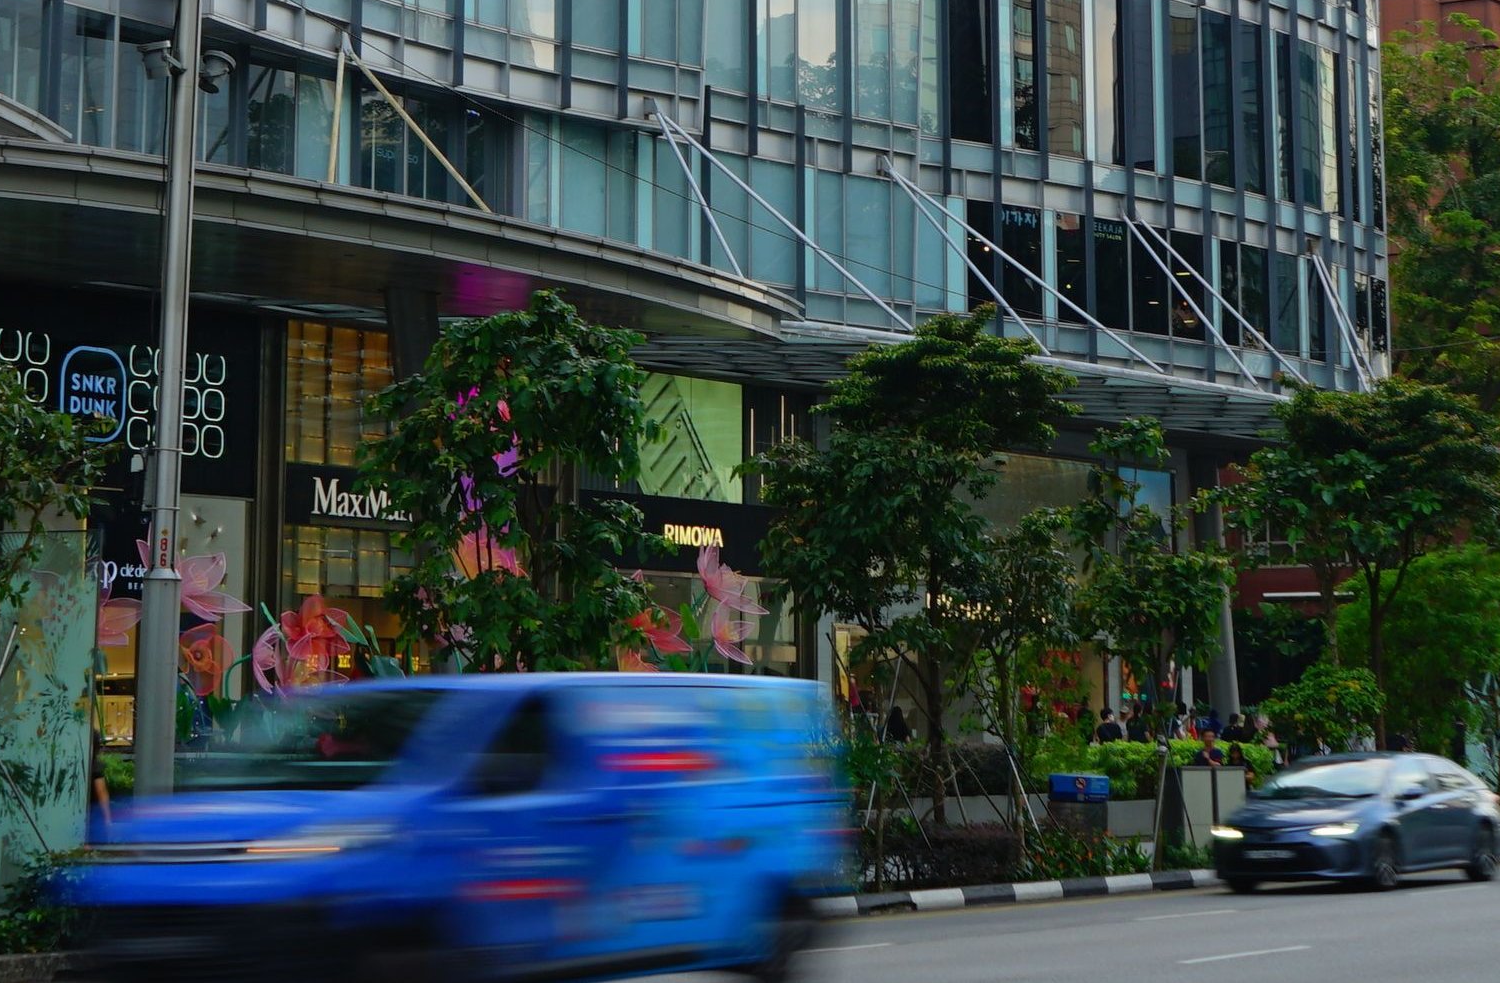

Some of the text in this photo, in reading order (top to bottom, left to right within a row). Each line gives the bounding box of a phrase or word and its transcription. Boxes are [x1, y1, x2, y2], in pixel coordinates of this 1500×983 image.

[1093, 221, 1124, 235] EEKAJA
[71, 372, 117, 396] SNKR
[69, 396, 117, 418] DUNK
[311, 477, 413, 522] MaxM
[664, 523, 724, 548] RIMOWA
